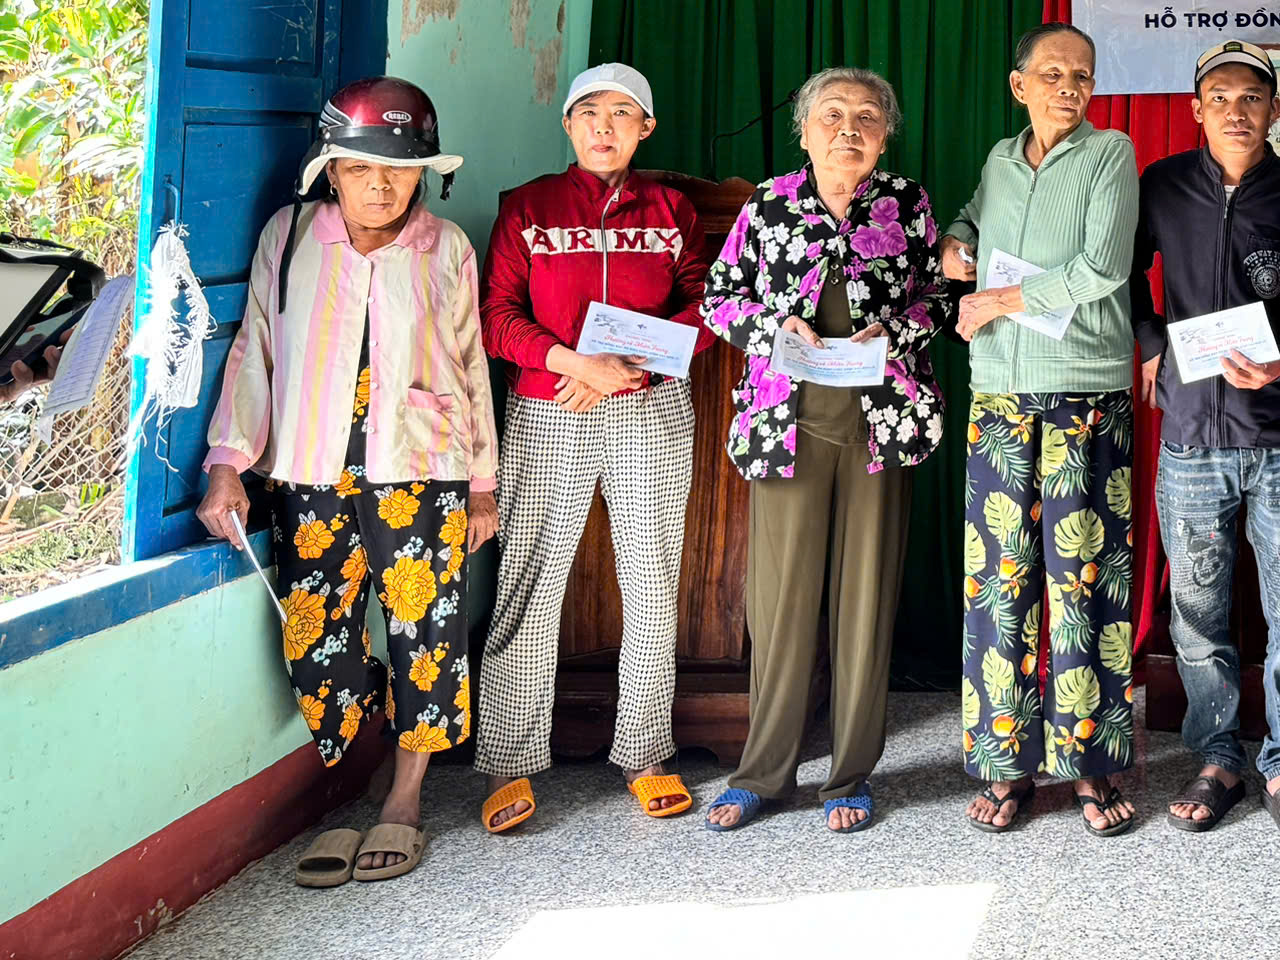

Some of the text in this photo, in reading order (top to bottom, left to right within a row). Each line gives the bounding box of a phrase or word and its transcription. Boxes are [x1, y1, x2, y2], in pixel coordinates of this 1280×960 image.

[1144, 6, 1177, 29] HỖ
[1183, 10, 1228, 32] TRỢ
[532, 227, 681, 253] ARMY
